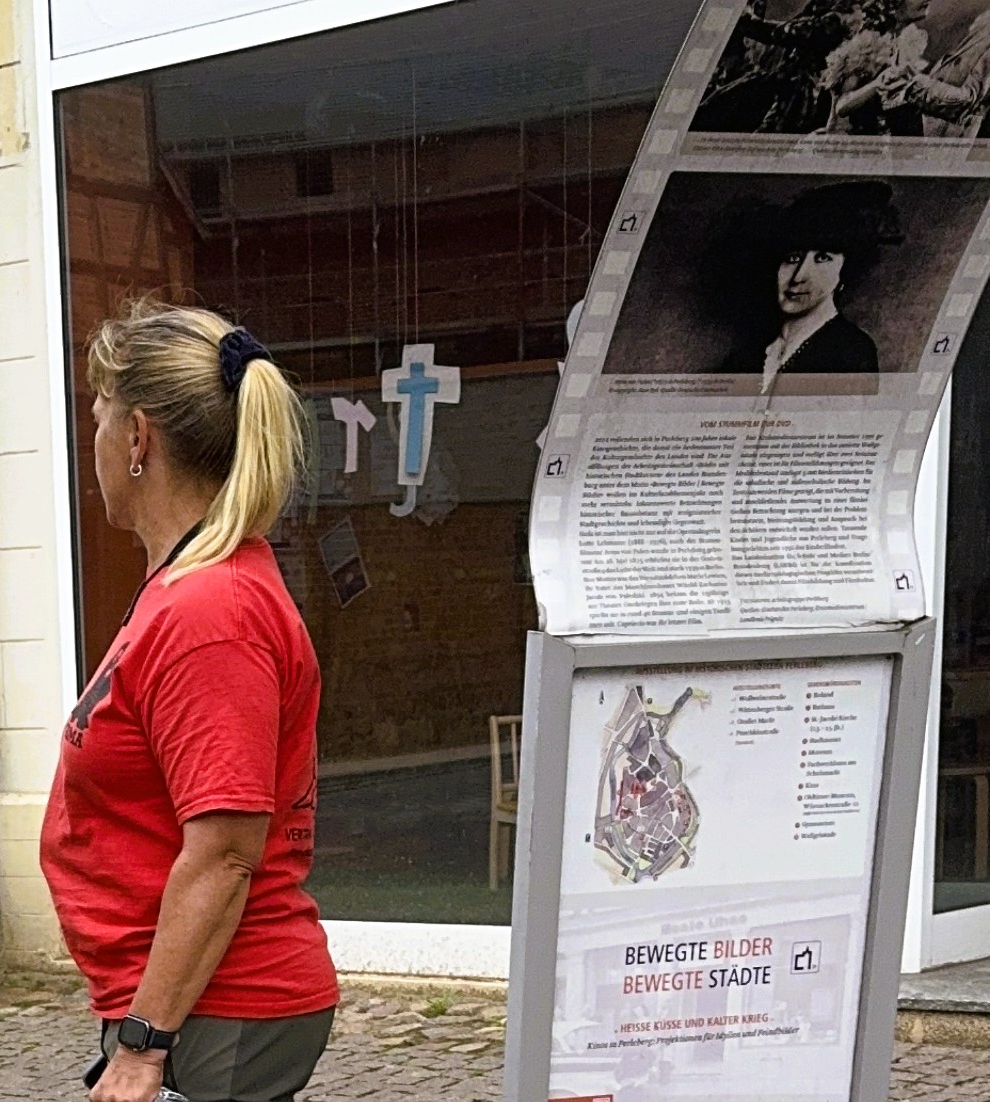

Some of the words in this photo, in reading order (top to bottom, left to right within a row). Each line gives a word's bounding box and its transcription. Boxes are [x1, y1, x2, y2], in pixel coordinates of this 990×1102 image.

[625, 941, 708, 966] BEWEGTE
[713, 936, 772, 959] BILDER
[623, 970, 704, 995] BEWEGTE
[709, 964, 771, 988] STÄDTE
[620, 1021, 651, 1033] HEISSE
[685, 1016, 705, 1029] UND
[707, 1015, 739, 1027] KALTER
[741, 1013, 769, 1025] KRIEG
